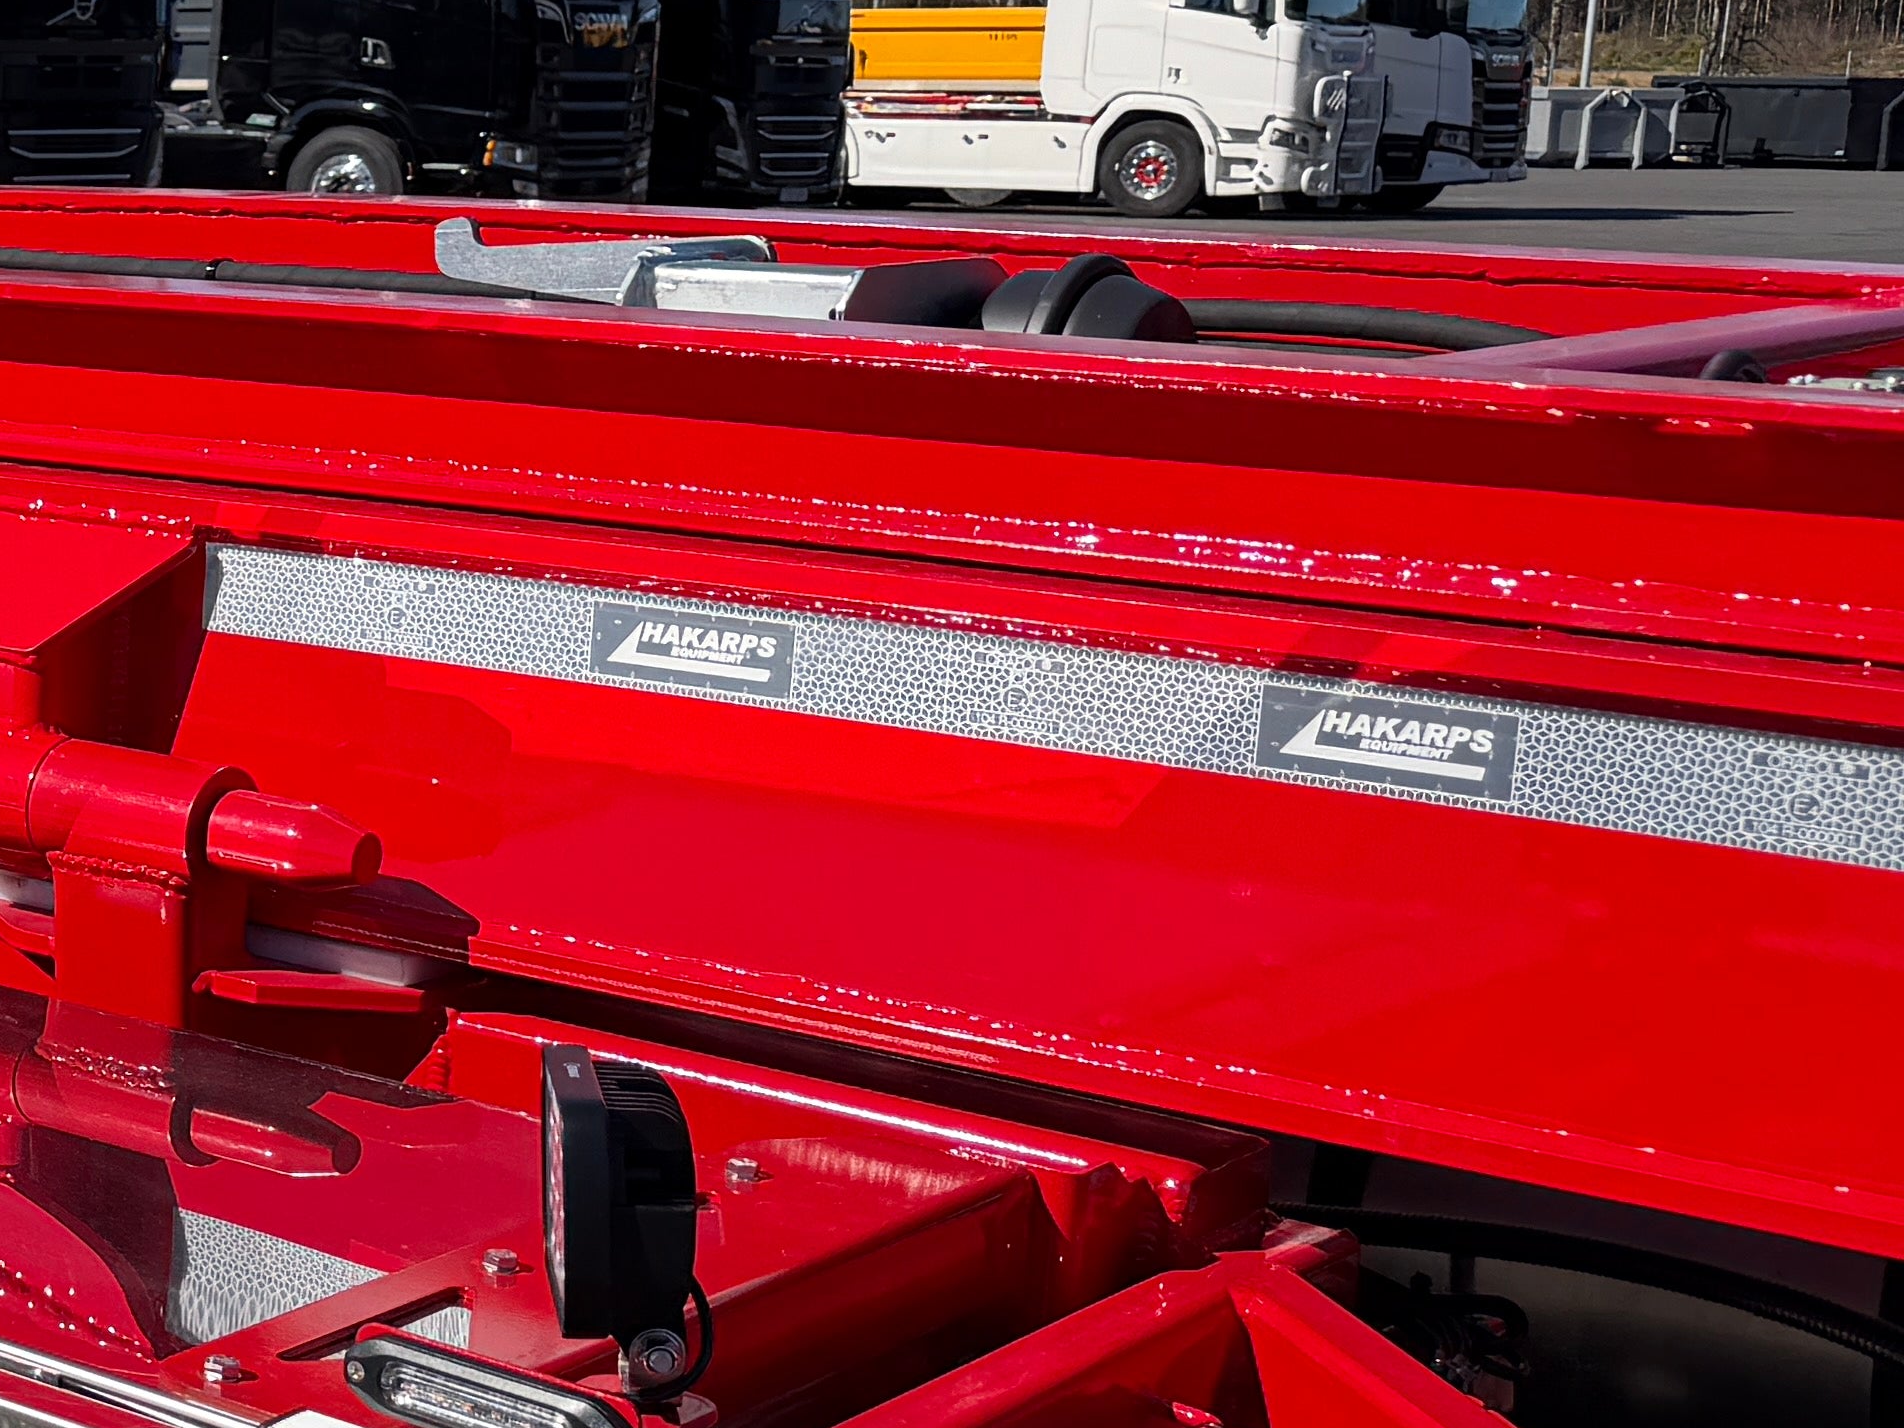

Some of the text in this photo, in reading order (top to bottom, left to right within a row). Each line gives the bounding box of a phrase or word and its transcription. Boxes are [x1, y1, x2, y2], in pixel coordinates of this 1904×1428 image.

[641, 622, 777, 659] HAKARPS
[670, 646, 745, 666] EQUIPMENT
[1322, 709, 1495, 754] HAKARPS
[1359, 737, 1454, 761] EQUIPMENT
